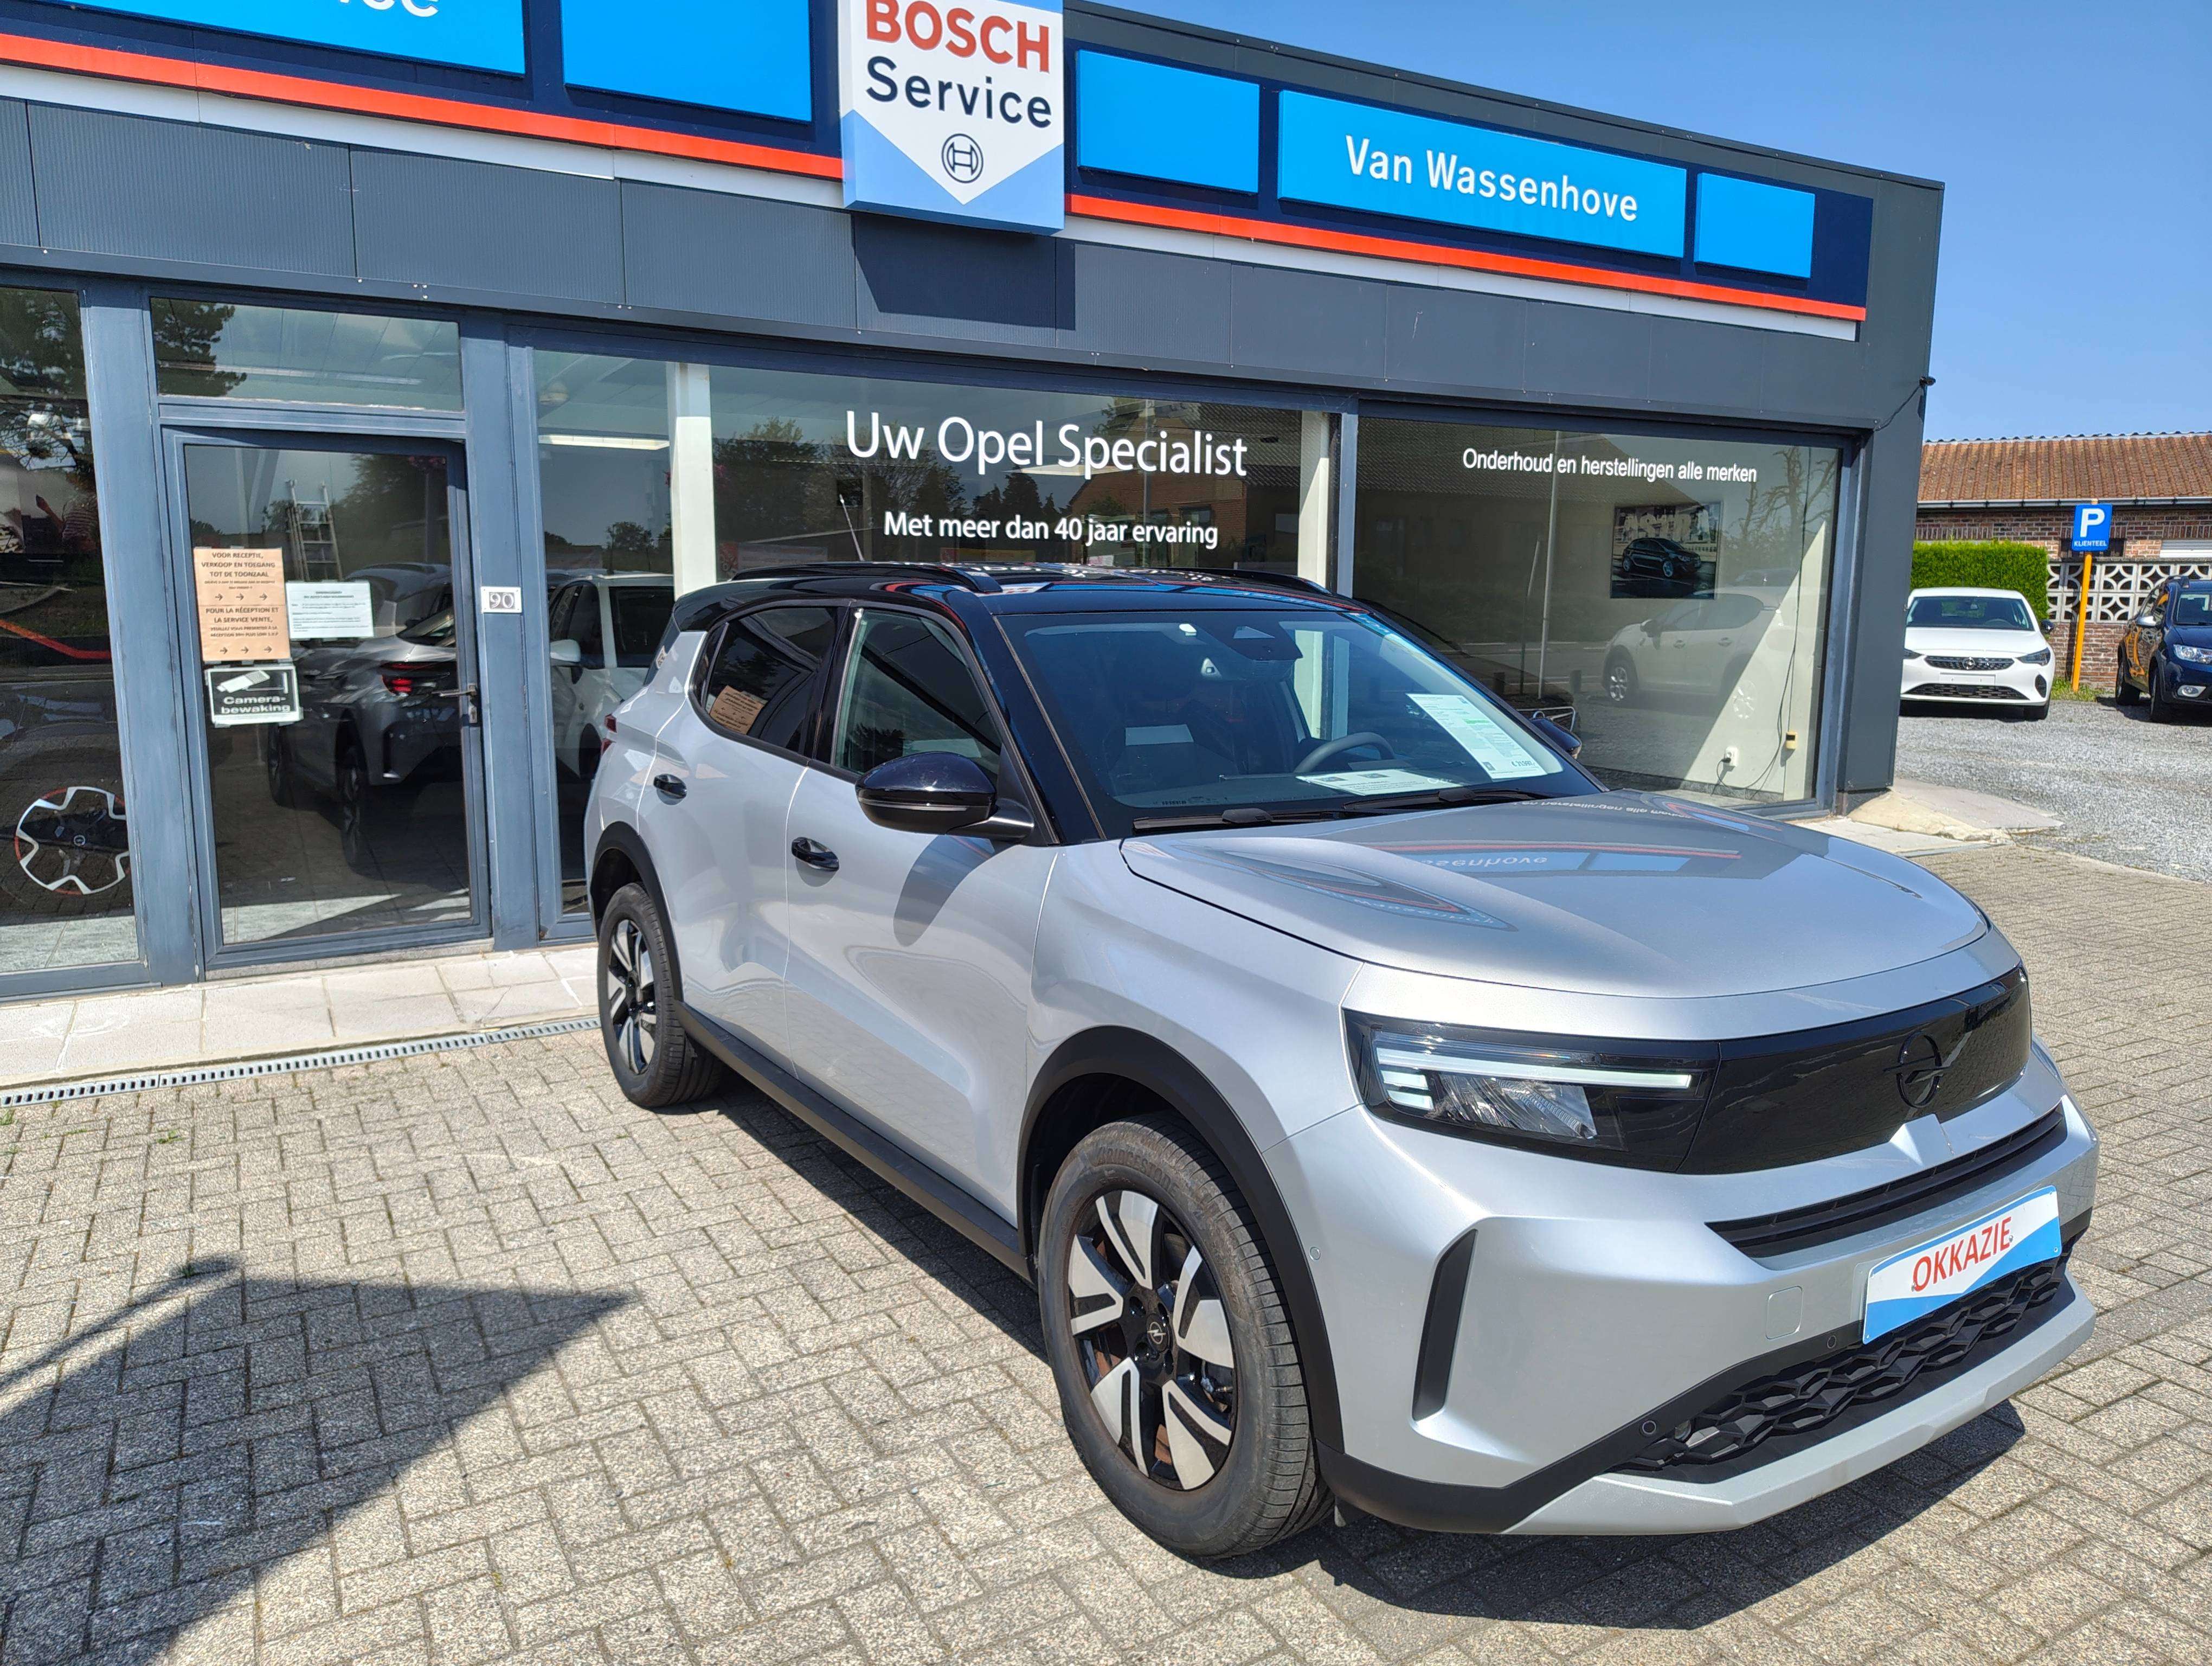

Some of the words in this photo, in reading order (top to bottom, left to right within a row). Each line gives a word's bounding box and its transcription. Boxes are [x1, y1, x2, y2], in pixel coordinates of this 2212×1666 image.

[866, 0, 1050, 73] BOSCH
[866, 55, 1051, 129] Service
[1346, 135, 1412, 184] Van
[1426, 150, 1637, 221] Wassenhove
[846, 411, 925, 460] Uw
[938, 416, 1044, 476] Opel
[1058, 424, 1248, 480] Specialist
[1463, 448, 1553, 473] Onderhoud
[1557, 458, 1576, 473] en
[1581, 455, 1674, 483] herstellingen
[1677, 460, 1703, 480] alle
[1707, 463, 1757, 483] merken
[884, 511, 933, 536] Met
[940, 519, 1000, 538] meer
[1006, 515, 1049, 539] dan
[1054, 518, 1082, 540] 40
[1085, 518, 1128, 547] jaar
[1132, 521, 1218, 549] ervaring
[2080, 508, 2105, 538] P
[490, 592, 515, 608] 90
[221, 704, 291, 714] bewaking
[223, 696, 287, 704] Camera-
[1912, 1216, 2012, 1293] OKKAZIE
